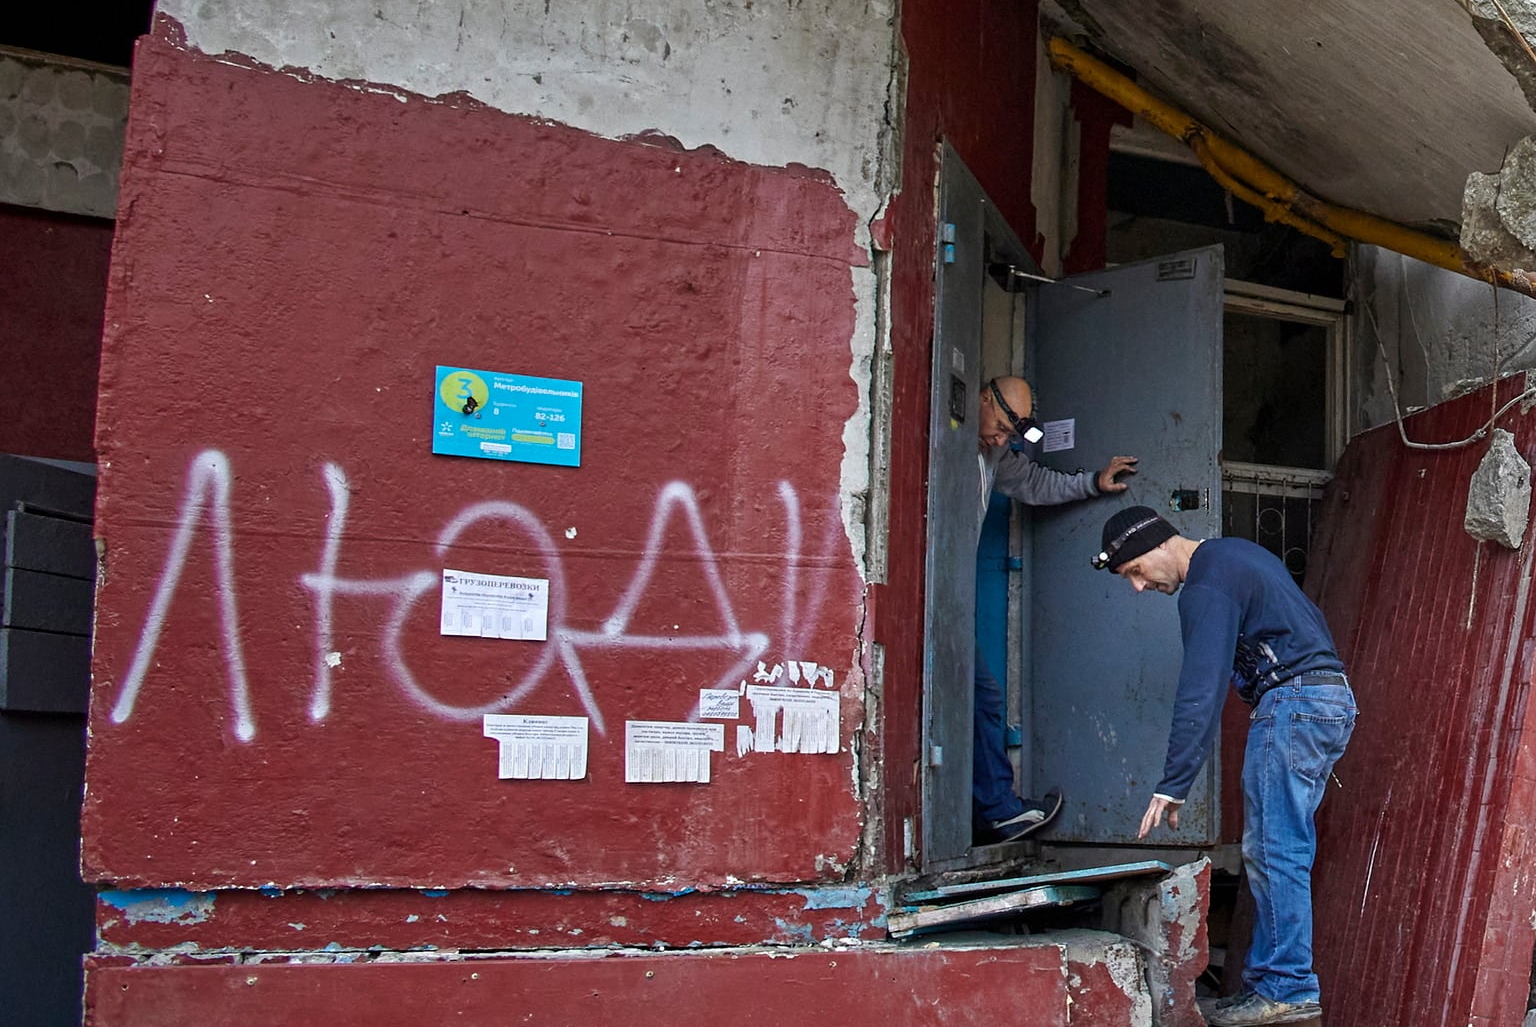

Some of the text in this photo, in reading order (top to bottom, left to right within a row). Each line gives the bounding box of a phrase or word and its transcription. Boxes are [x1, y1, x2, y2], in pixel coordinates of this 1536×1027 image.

[456, 378, 473, 399] 3
[535, 413, 566, 422] 82-126
[459, 577, 540, 592] ГРУЗОПЕРЕВОЗКИ
